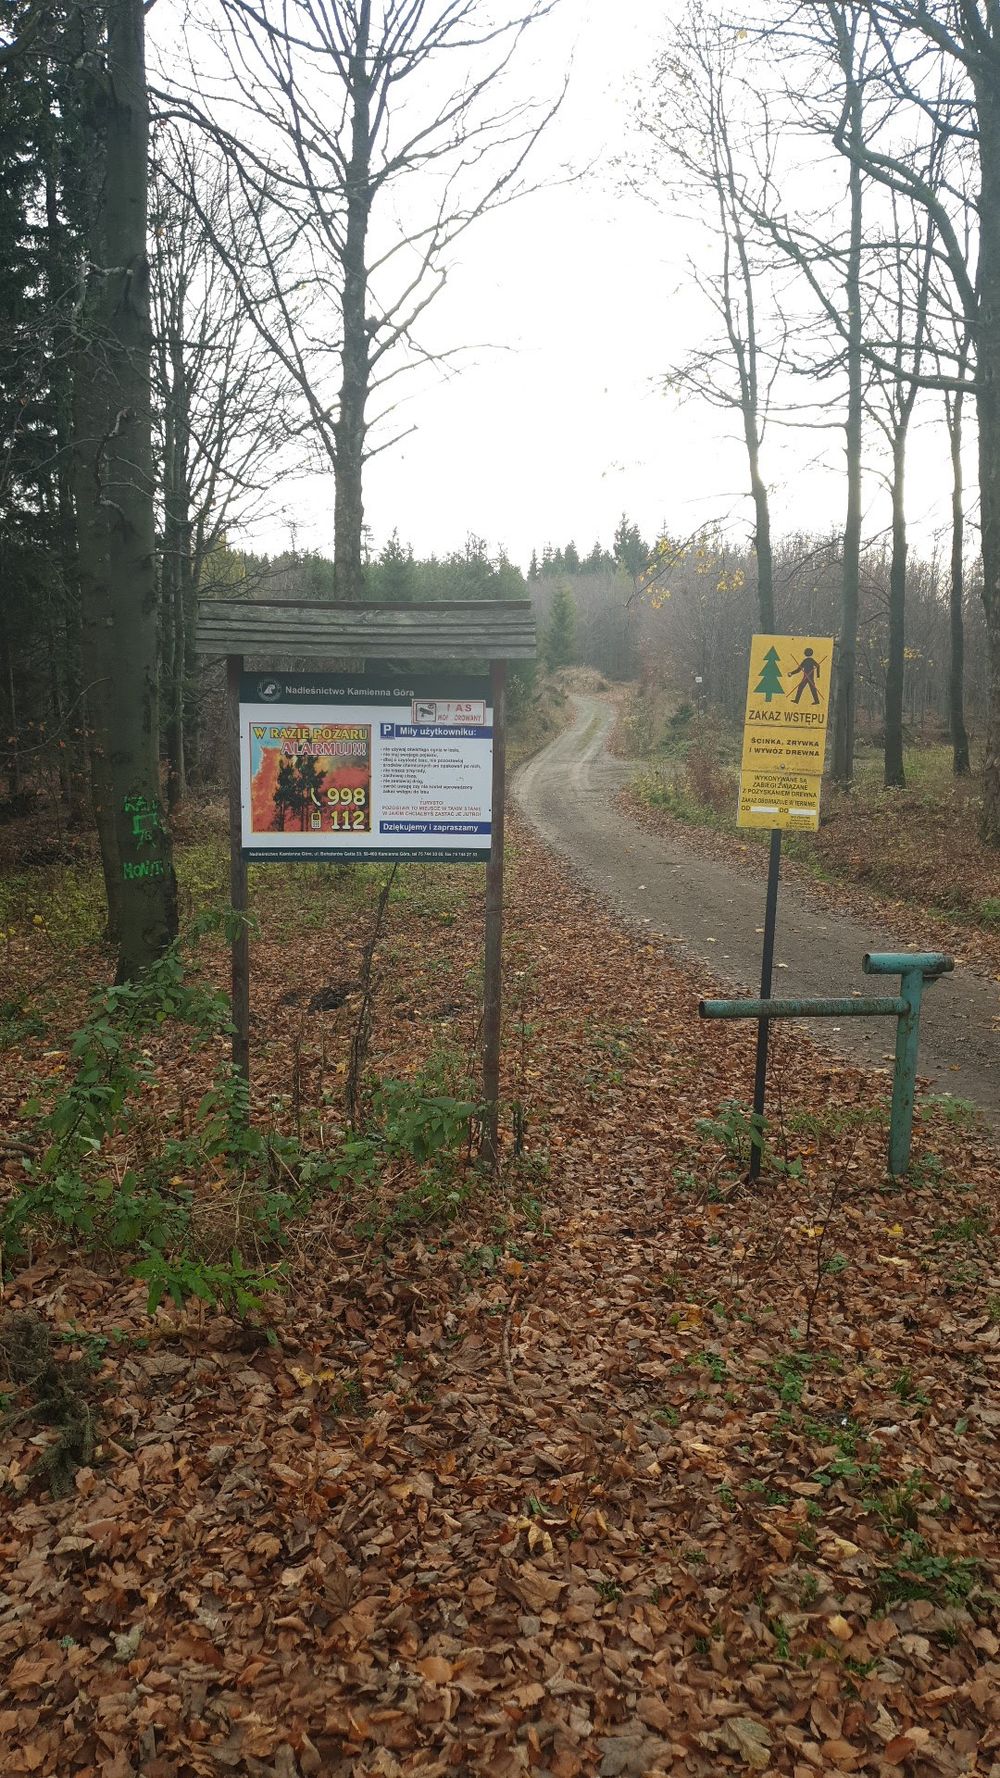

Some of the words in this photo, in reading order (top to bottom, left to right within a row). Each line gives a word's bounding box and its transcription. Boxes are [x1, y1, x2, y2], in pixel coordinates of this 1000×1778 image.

[285, 686, 345, 696] Nadleśnictwo
[347, 687, 391, 697] Kamienna
[393, 688, 415, 697] Góra
[748, 710, 781, 721] ZAKAZ
[784, 711, 825, 726] WSTĘPU
[253, 727, 267, 739] W
[270, 727, 310, 740] RAZIE
[383, 725, 392, 735] P
[400, 727, 418, 737] Miły
[420, 727, 477, 737] użytkowniku:
[751, 737, 784, 746] ŚCINKA,
[786, 739, 820, 747] ZRYWKA
[281, 741, 367, 756] ALARMUJ!!!
[754, 747, 783, 755] WYWÓZ
[327, 787, 366, 806] 998
[331, 810, 366, 830] 112
[383, 823, 428, 832] Dziękujemy
[433, 824, 479, 832] zapraszamy
